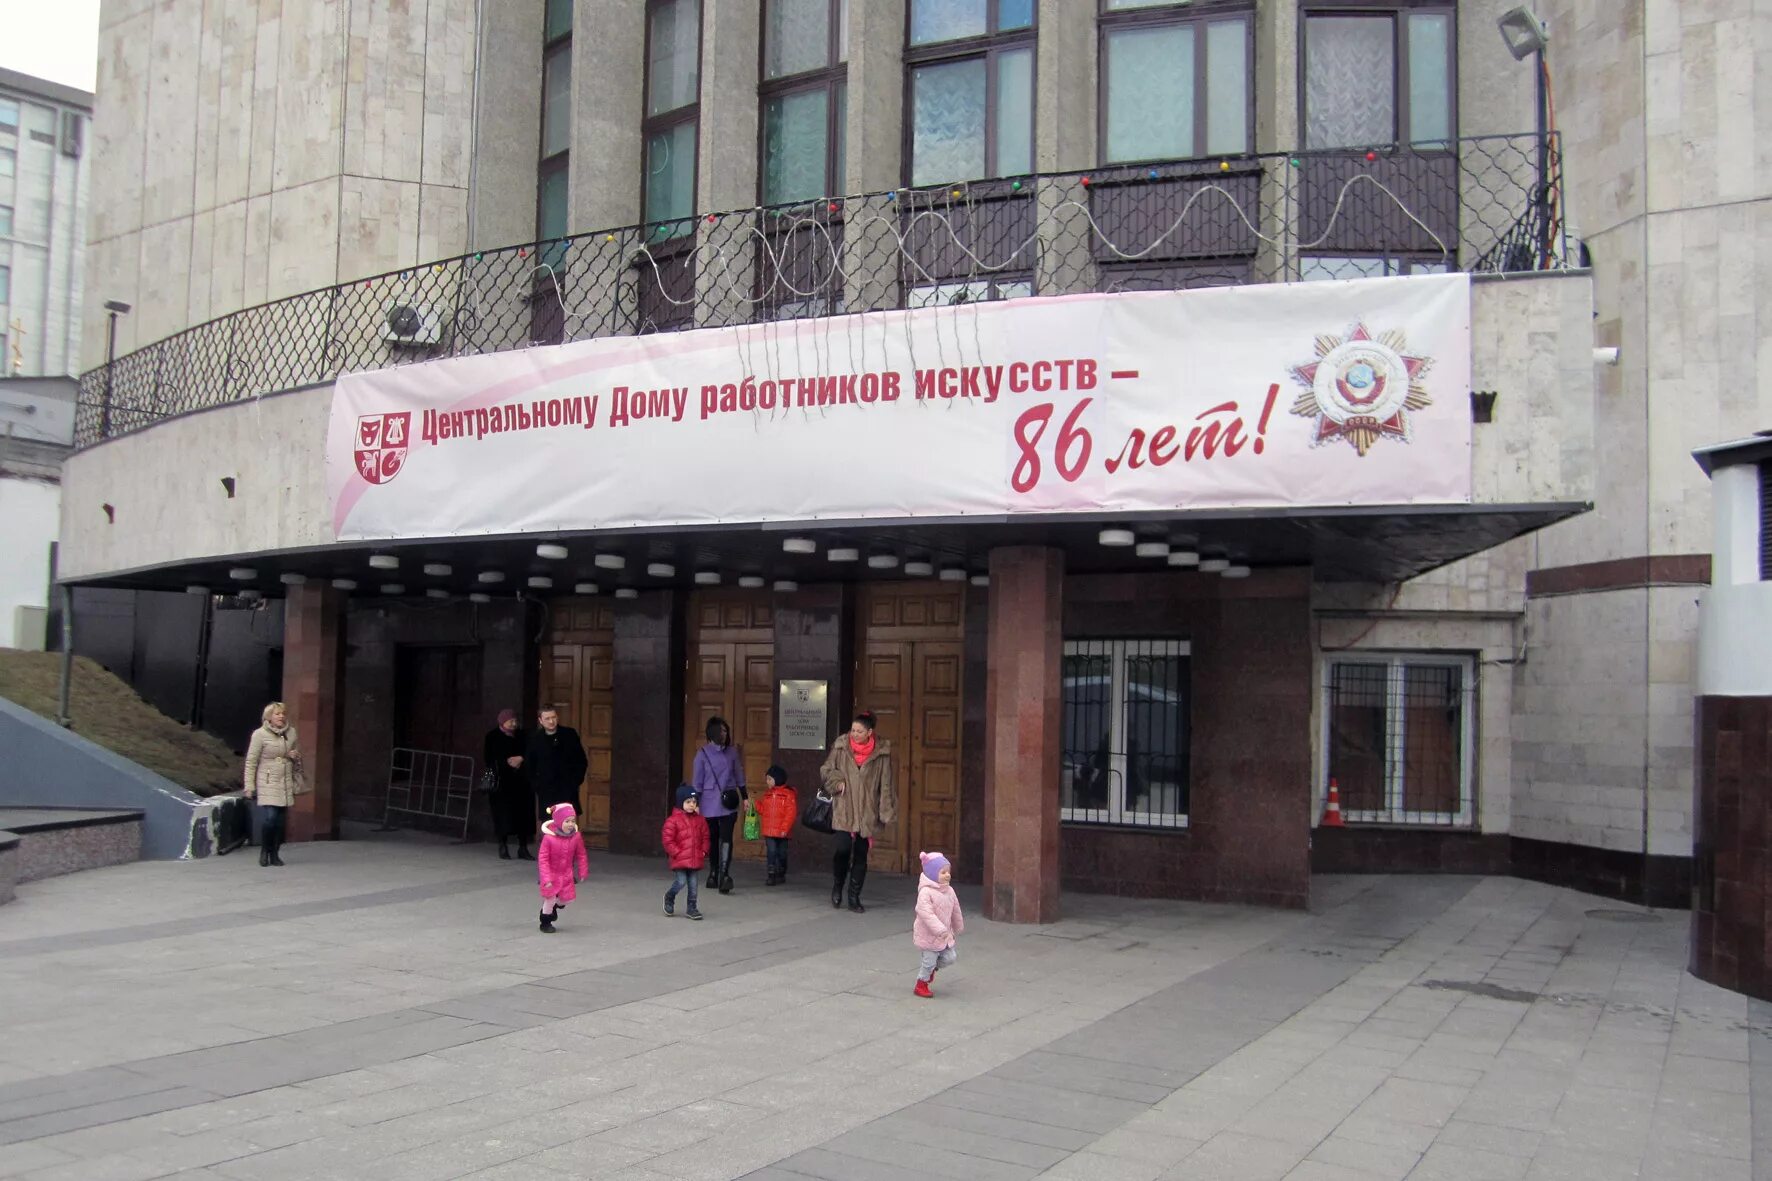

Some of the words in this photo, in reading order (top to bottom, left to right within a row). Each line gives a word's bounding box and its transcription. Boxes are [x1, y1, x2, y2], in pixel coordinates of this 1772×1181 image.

[421, 394, 598, 446] Центральному
[609, 386, 688, 429] Дому
[701, 371, 900, 420] работников
[915, 359, 1097, 404] искусств
[1011, 397, 1093, 494] 86
[1104, 383, 1280, 475] лет!
